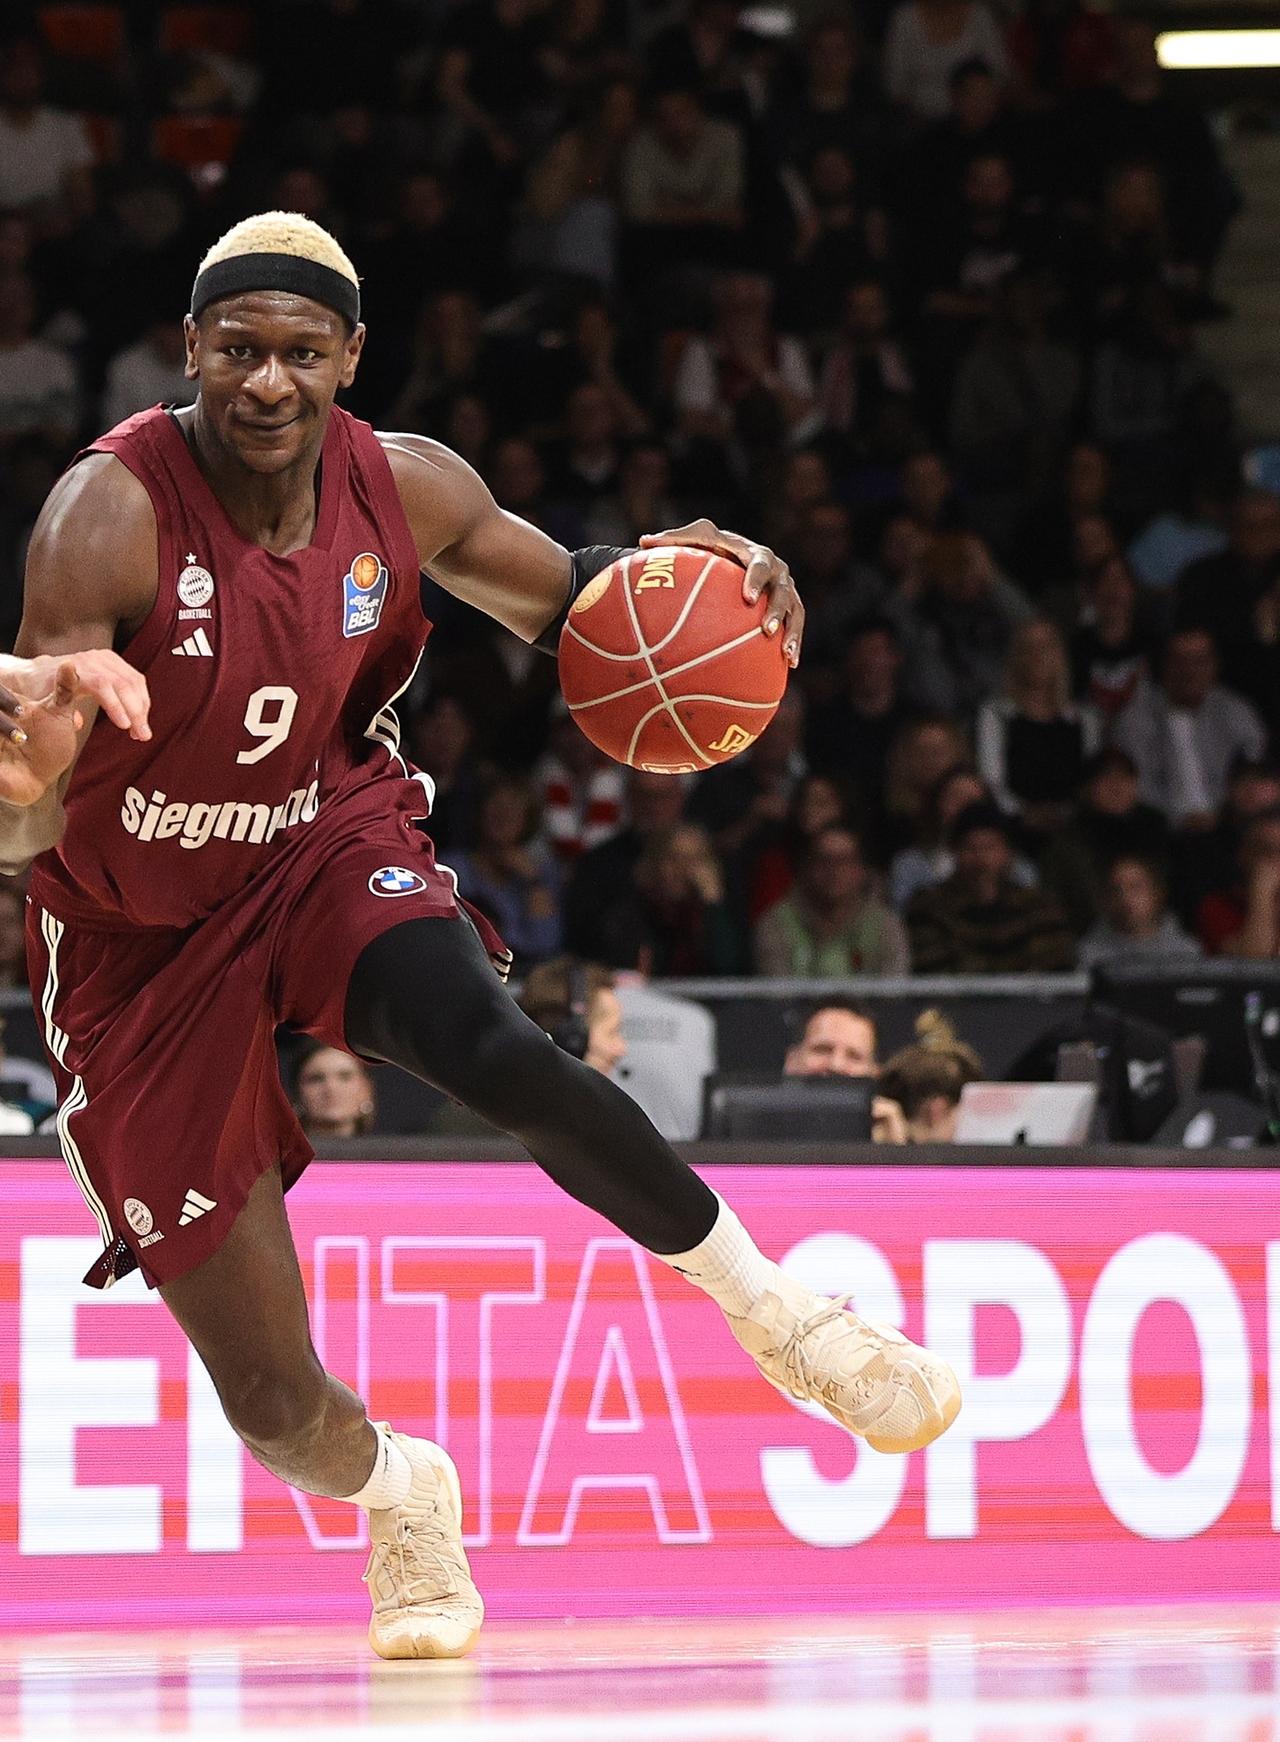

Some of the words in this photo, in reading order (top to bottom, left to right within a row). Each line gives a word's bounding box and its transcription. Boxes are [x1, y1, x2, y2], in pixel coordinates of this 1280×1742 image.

[347, 607, 375, 630] BBL
[236, 685, 298, 765] 9
[759, 1232, 1280, 1548] SPO
